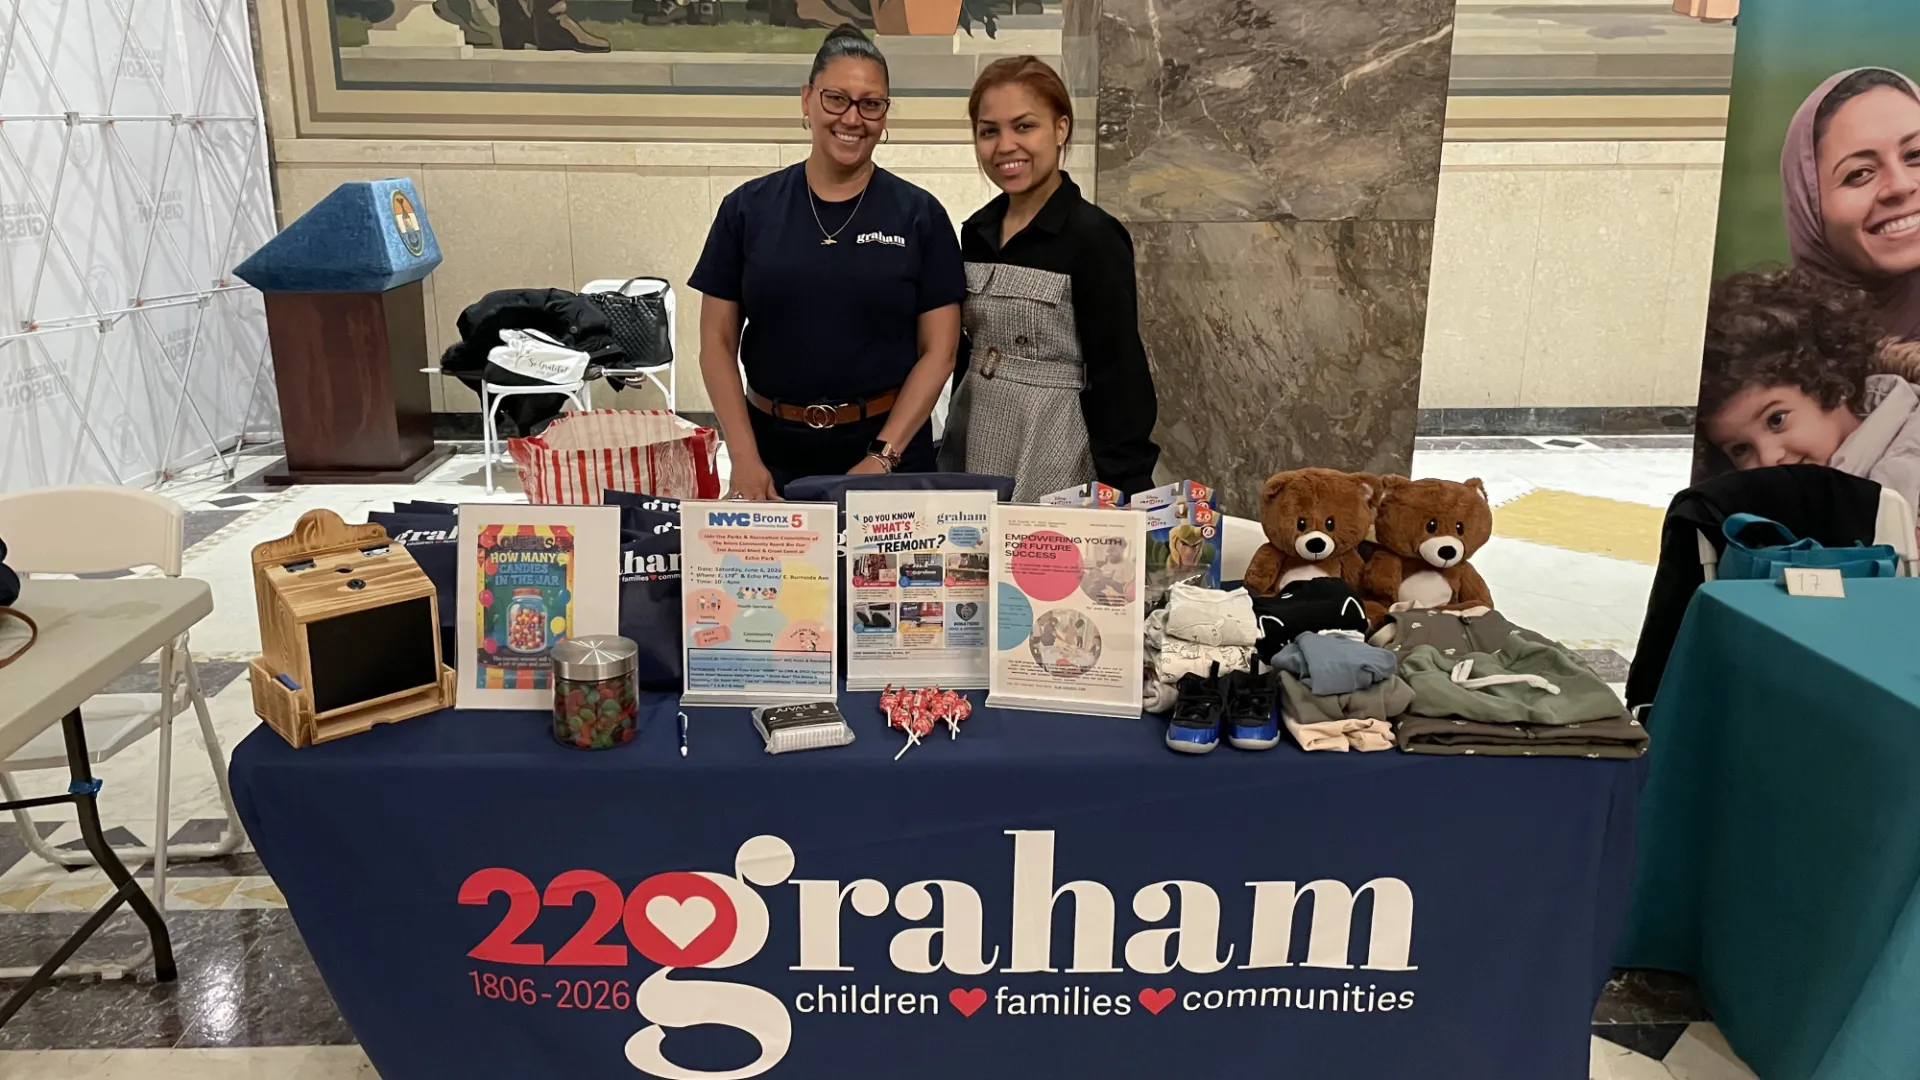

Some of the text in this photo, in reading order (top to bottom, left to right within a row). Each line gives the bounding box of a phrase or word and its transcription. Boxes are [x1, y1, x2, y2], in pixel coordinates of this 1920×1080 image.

[856, 230, 906, 247] graham
[1098, 489, 1113, 500] 2.0
[708, 512, 803, 529] NYC Bronx 5
[875, 514, 890, 522] YOU
[891, 512, 916, 521] KNOW
[937, 511, 987, 524] graham
[1195, 512, 1211, 522] 2.0
[872, 521, 911, 534] WHAT'S
[864, 533, 901, 543] AVAILABLE
[876, 534, 946, 553] TREMONT?
[1004, 533, 1123, 546] EMPOWERING YOUTH
[1004, 542, 1072, 552] FOR FUTURE
[490, 551, 557, 563] HOW MANY
[1004, 549, 1057, 559] SUCCESS
[499, 563, 549, 574] CANDIES
[495, 574, 560, 586] IN THE JAR
[621, 574, 649, 582] families
[775, 704, 817, 713] JUVALE
[624, 829, 1419, 1080] graham
[468, 970, 630, 1010] 1806-2026
[795, 982, 1415, 1016] children families communities
